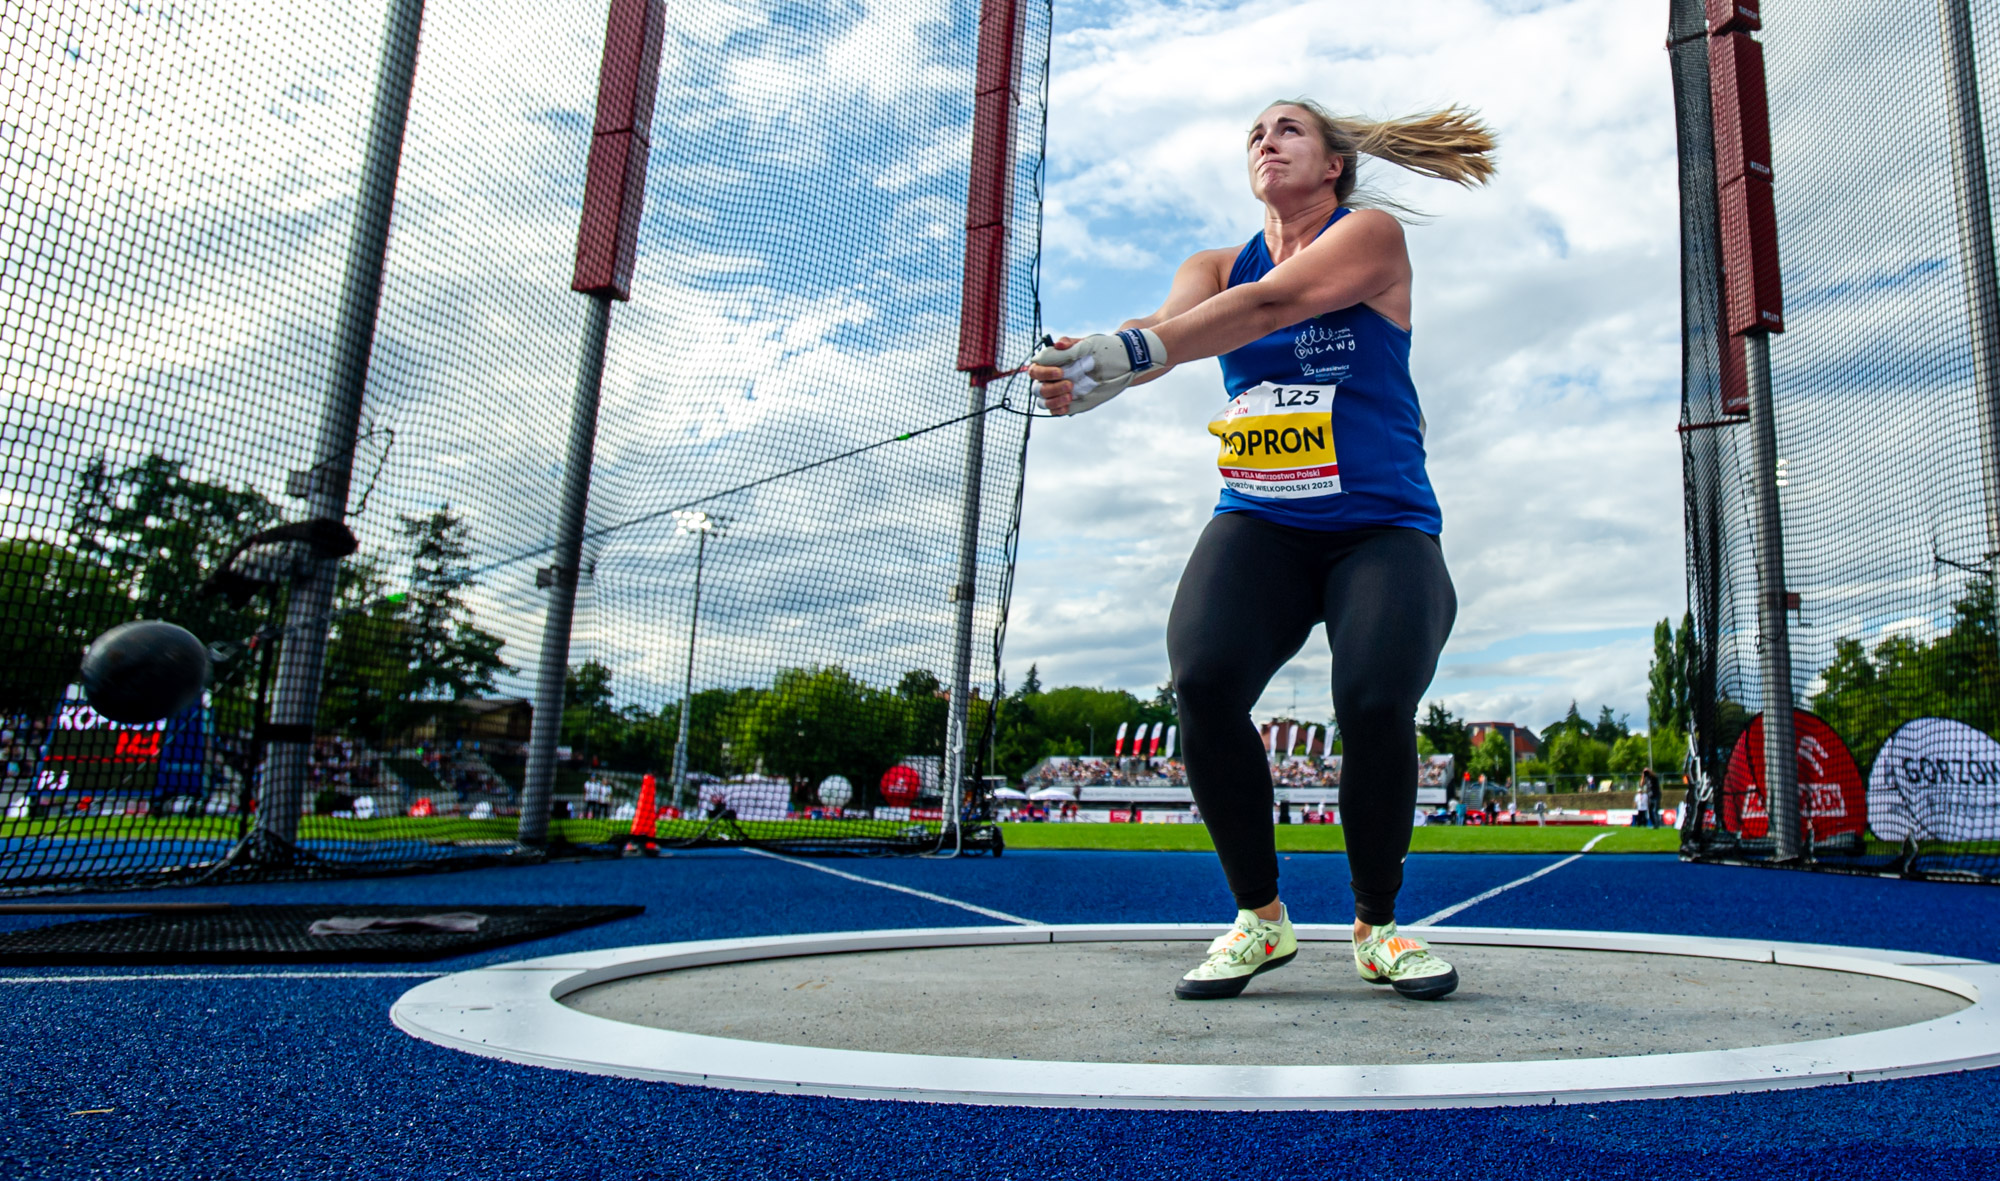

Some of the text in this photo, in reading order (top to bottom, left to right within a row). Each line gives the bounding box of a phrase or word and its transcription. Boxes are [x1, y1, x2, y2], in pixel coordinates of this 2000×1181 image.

[1297, 339, 1356, 357] PUŁAWY
[1272, 387, 1320, 407] 125
[1224, 406, 1249, 417] OLEN
[1255, 471, 1295, 481] Mistrzostwa
[1296, 468, 1321, 479] Polski
[1255, 482, 1310, 492] WIELKOPOLSKI
[1312, 480, 1334, 490] 2023
[1387, 937, 1422, 959] NIKE
